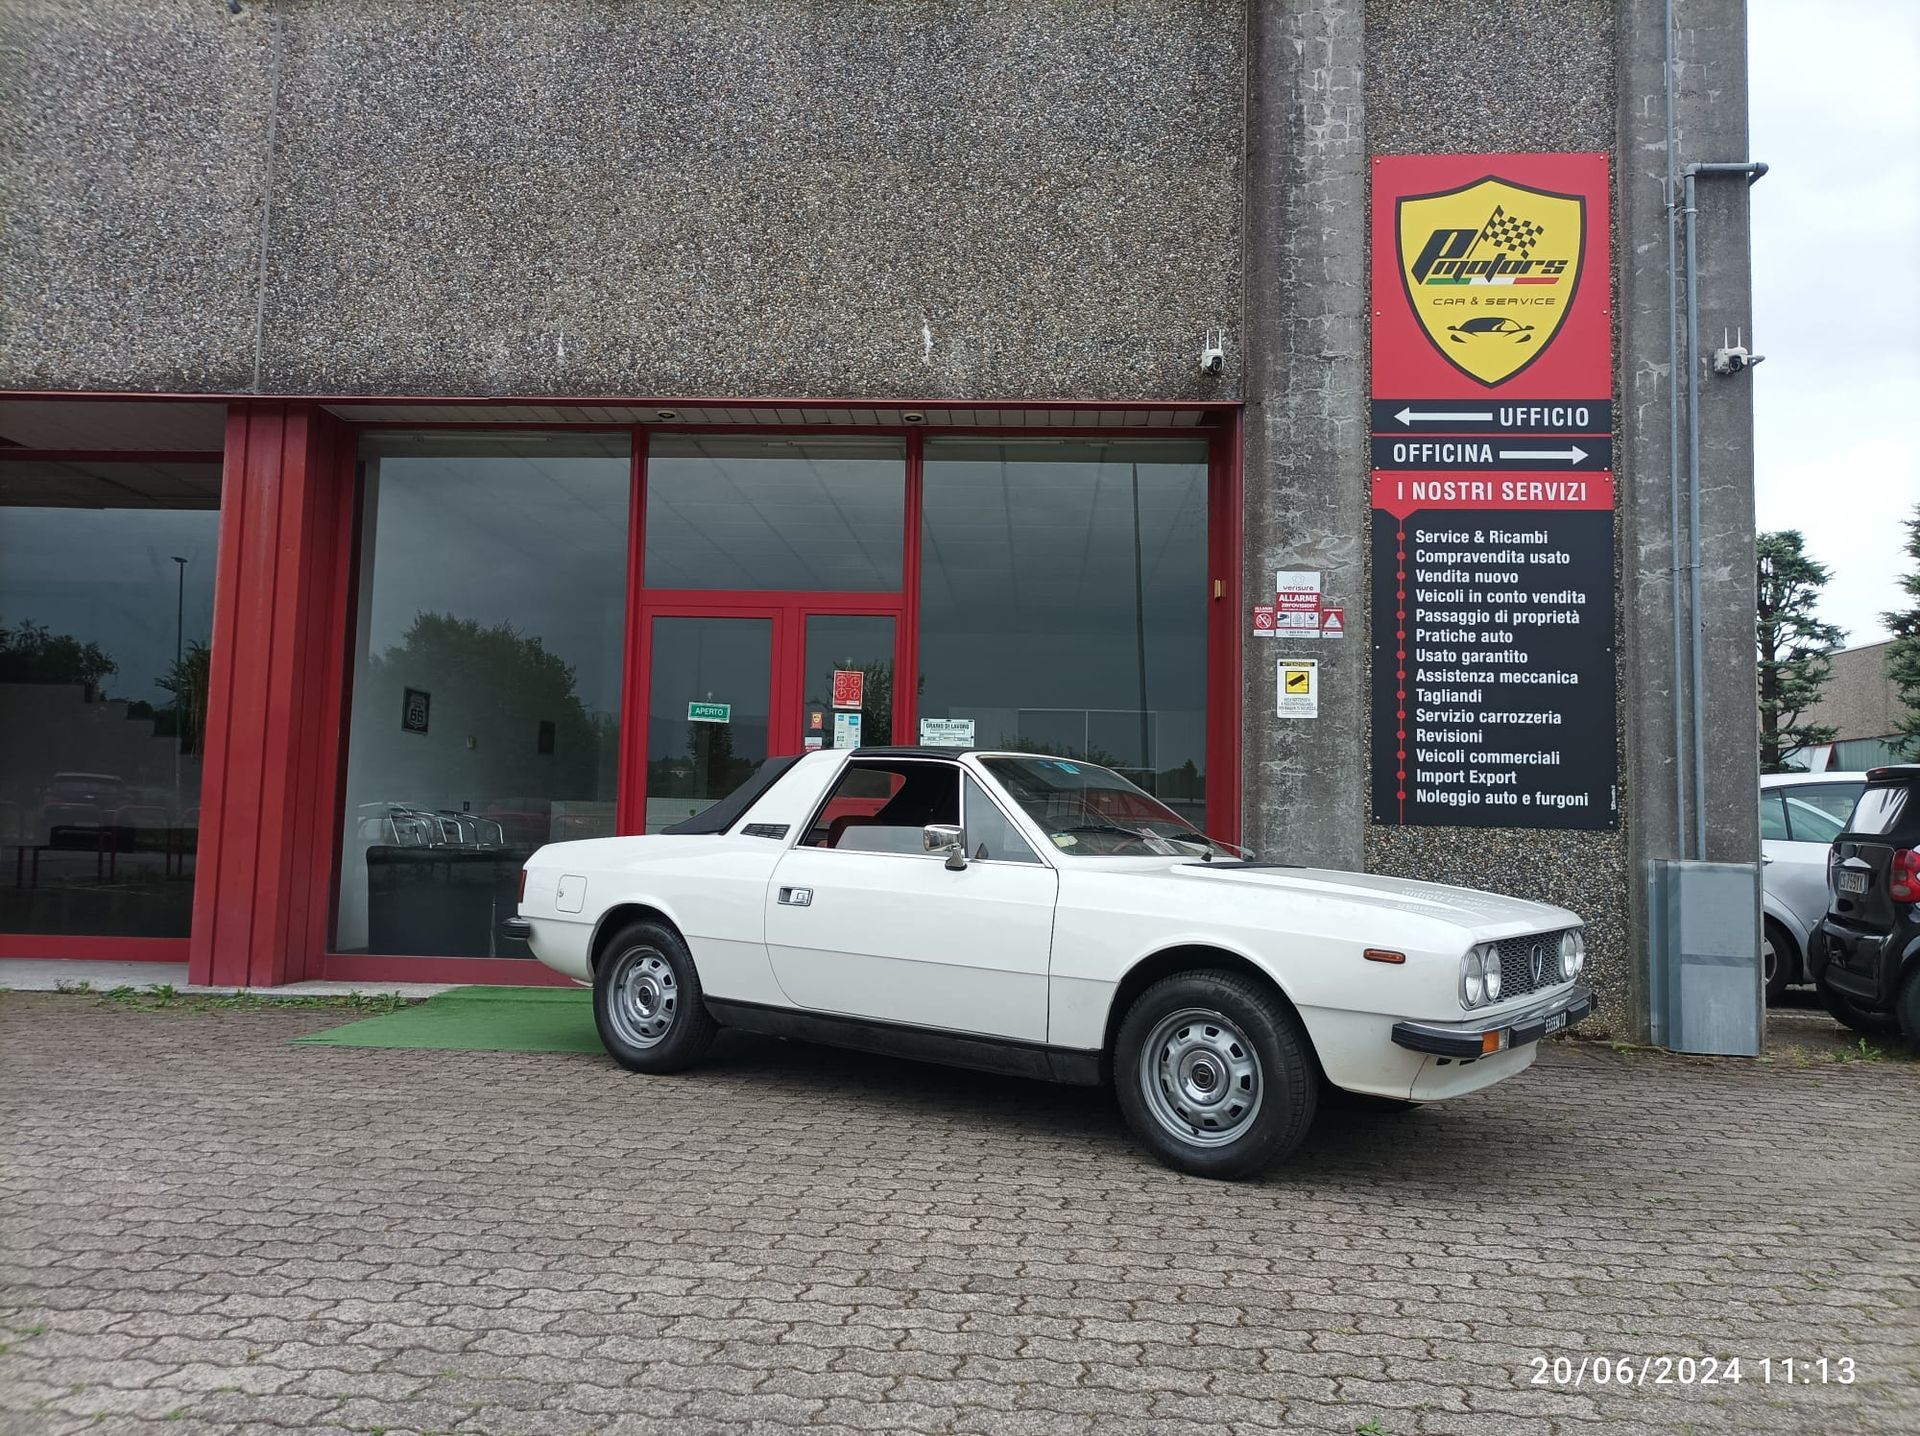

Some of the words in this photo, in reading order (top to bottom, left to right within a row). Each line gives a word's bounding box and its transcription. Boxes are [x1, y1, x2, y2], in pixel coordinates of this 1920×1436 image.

[1431, 253, 1568, 282] motors
[1432, 298, 1466, 306] CAR
[1470, 296, 1479, 306] &
[1485, 297, 1556, 306] SERVICE
[1500, 407, 1589, 426] UFFICIO
[1393, 444, 1494, 463] OFFICINA
[1397, 482, 1404, 500] I
[1412, 482, 1493, 500] NOSTRI
[1501, 482, 1586, 501] SERVIZI
[1416, 530, 1470, 543] Service
[1474, 531, 1485, 543] &
[1489, 530, 1549, 544] Ricambi
[1416, 550, 1525, 565] Compravendita
[1529, 552, 1570, 564] usato
[1416, 569, 1470, 583] Vendita
[1475, 572, 1519, 583] nuovo
[1416, 589, 1464, 603] Veicoli
[1469, 590, 1482, 603] in
[1487, 592, 1527, 603] conto
[1532, 590, 1586, 604] vendita
[1416, 609, 1490, 625] Passaggio
[1494, 610, 1508, 623] di
[1513, 610, 1580, 626] proprietà
[1416, 628, 1476, 643] Pratiche
[1481, 631, 1513, 643] auto
[1416, 649, 1457, 662] Usato
[1461, 650, 1528, 666] garantito
[1416, 669, 1494, 683] Assistenza
[1499, 671, 1579, 684] meccanica
[1416, 688, 1482, 705] Tagliandi
[410, 709, 423, 722] 66
[695, 707, 724, 716] APERTO
[1416, 709, 1475, 723] Servizio
[1479, 711, 1562, 724] carrozzeria
[1416, 729, 1483, 743] Revisioni
[1416, 749, 1465, 763] Veicoli
[1469, 751, 1560, 764] commerciali
[1416, 769, 1465, 785] Import
[1469, 770, 1517, 786] Export
[1416, 789, 1481, 806] Noleggio
[1485, 791, 1518, 804] auto
[1522, 795, 1531, 805] e
[1535, 791, 1589, 808] furgoni
